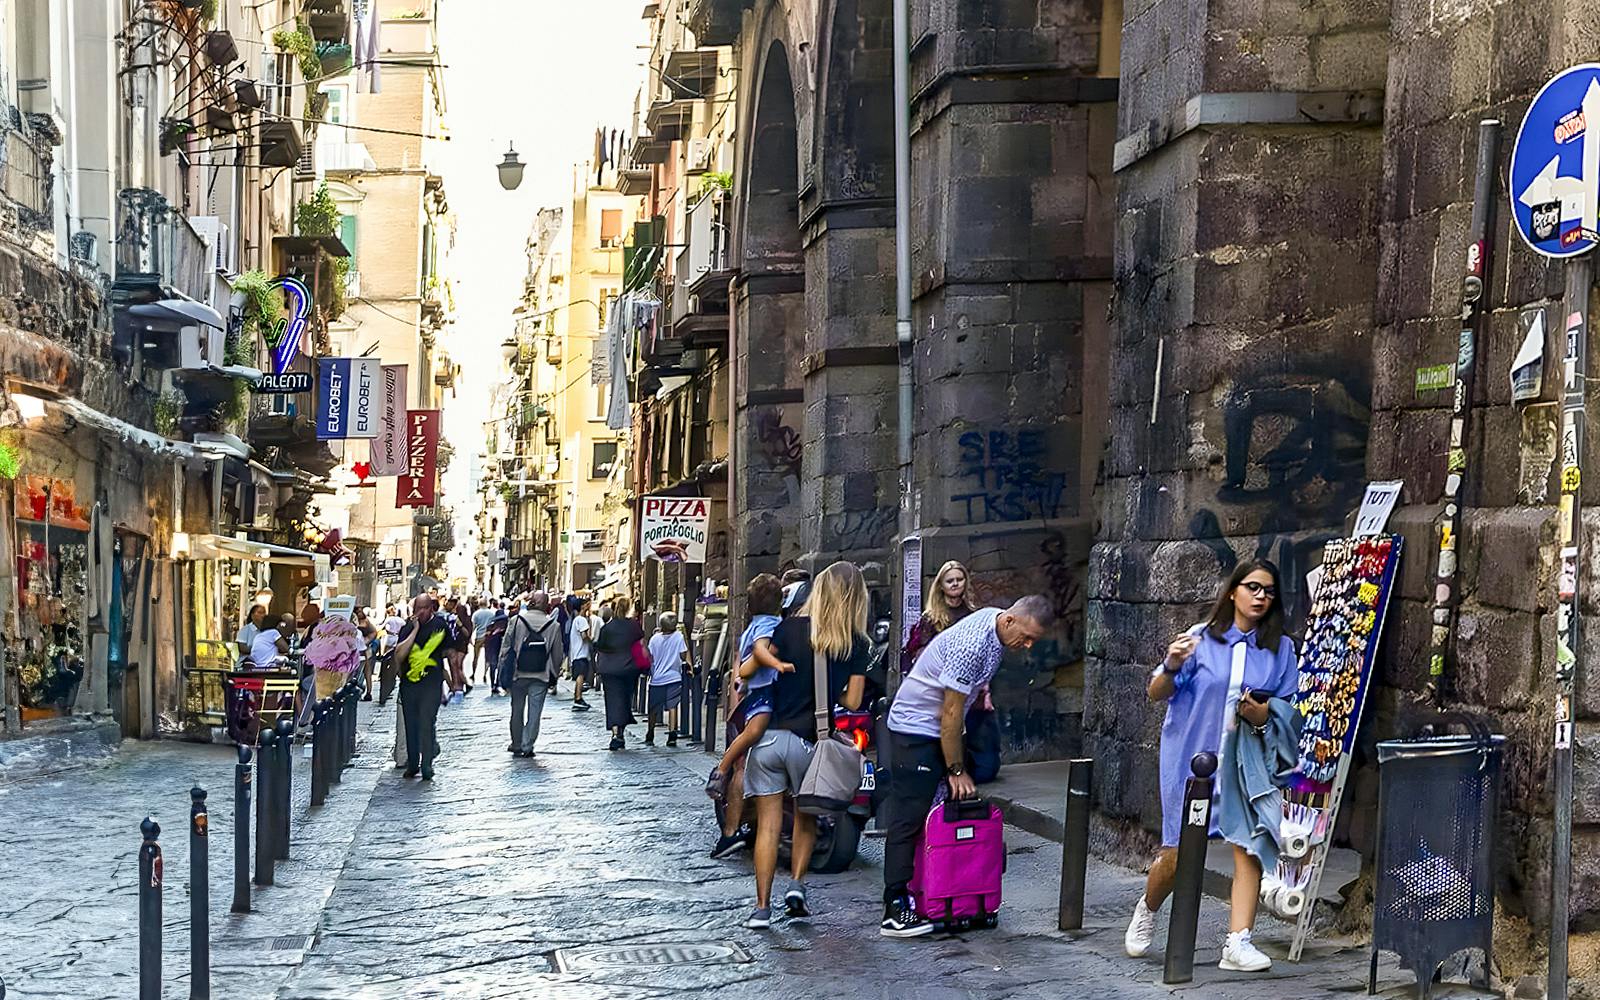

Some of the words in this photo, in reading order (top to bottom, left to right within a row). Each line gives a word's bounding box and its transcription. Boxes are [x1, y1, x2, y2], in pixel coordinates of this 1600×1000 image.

[254, 374, 308, 388] VALENTI
[357, 371, 370, 432] EUROBET
[328, 371, 342, 433] EUROBET
[408, 415, 427, 499] PIZZERIA
[645, 499, 706, 516] PIZZA
[644, 524, 704, 545] PORTAFOGLIO
